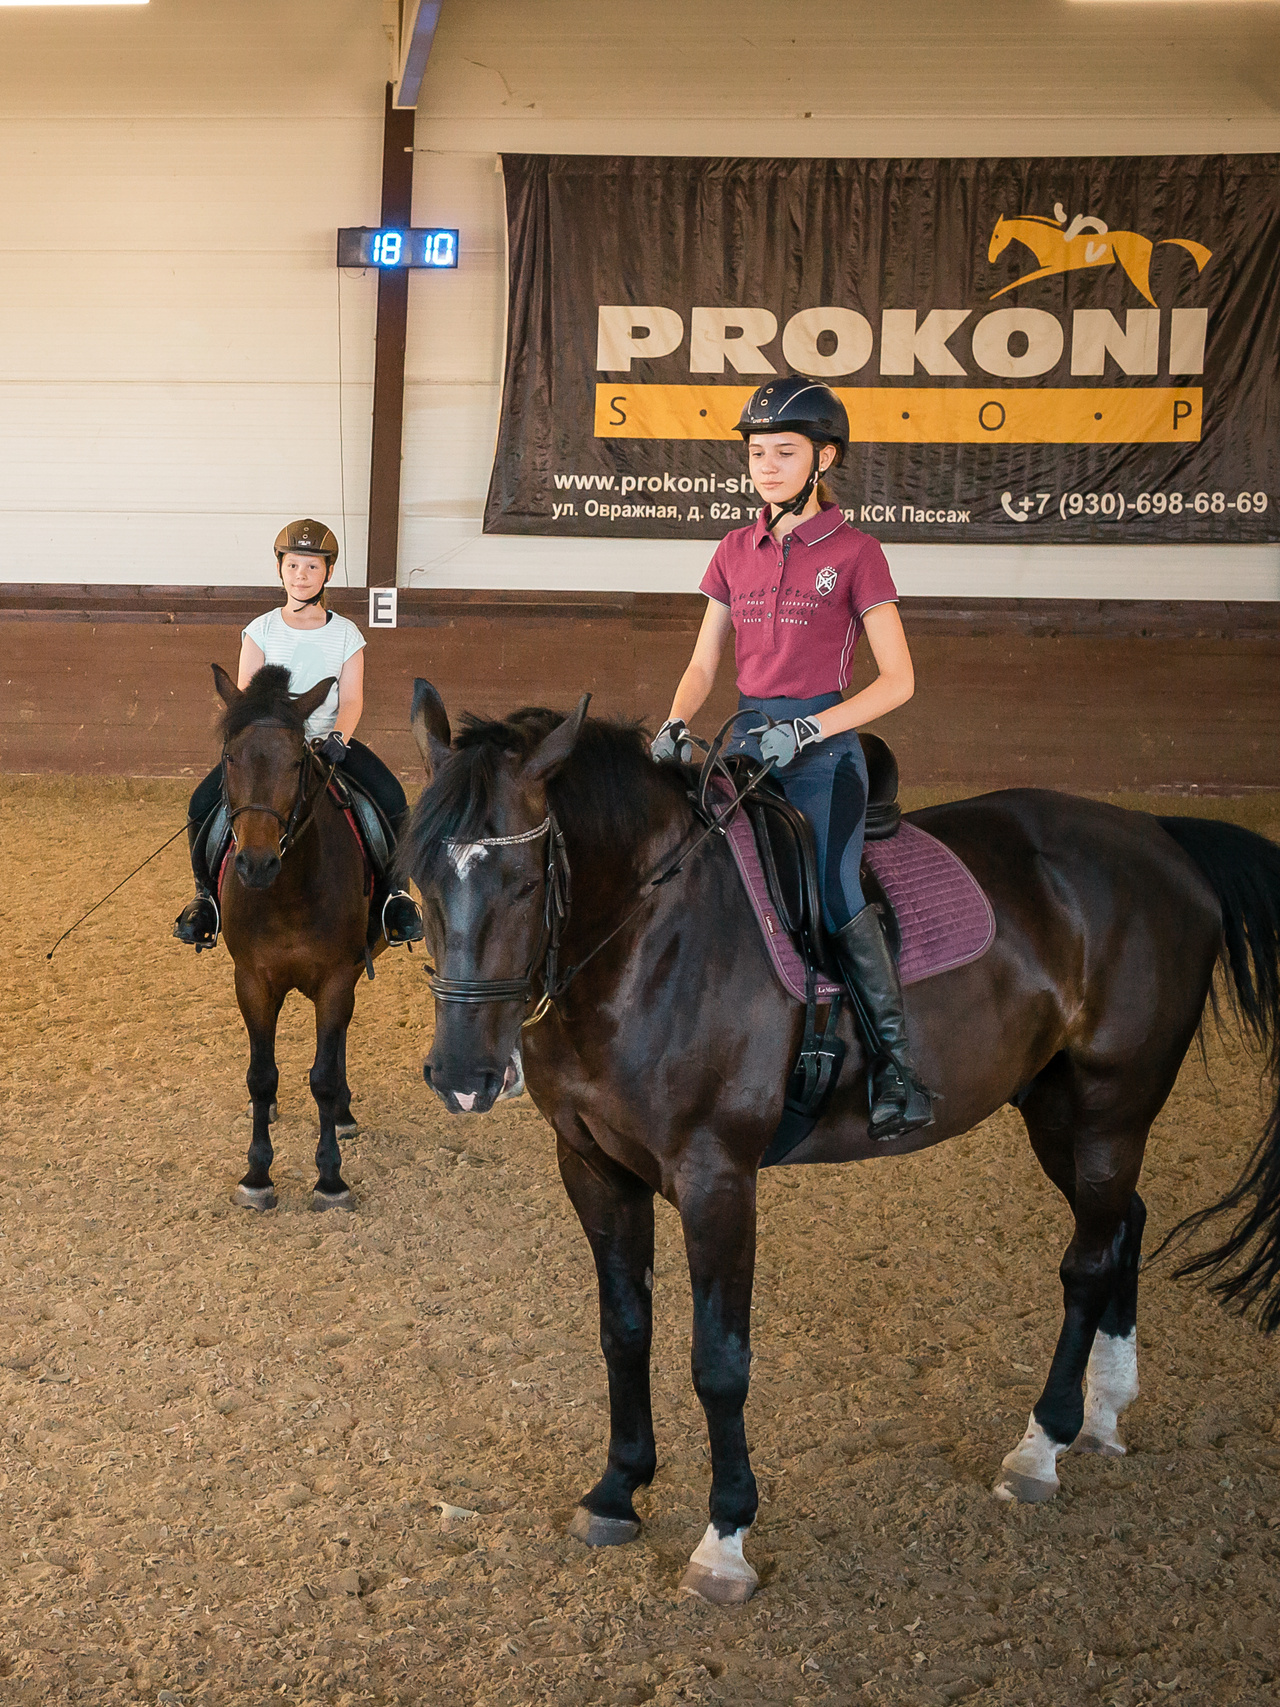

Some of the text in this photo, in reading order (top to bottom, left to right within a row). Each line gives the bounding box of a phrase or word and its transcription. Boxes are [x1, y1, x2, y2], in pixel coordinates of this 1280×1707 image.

[373, 232, 453, 265] 18 10
[596, 305, 1209, 378] PROKONI
[554, 472, 755, 496] www.prokoni-sh
[551, 502, 579, 519] ул.
[584, 499, 682, 522] Овражная,
[686, 505, 705, 522] д.
[710, 502, 741, 520] 62а
[860, 505, 897, 523] КСК
[901, 505, 971, 523] Пассаж
[1018, 491, 1269, 520] +7 (930)-698-68-69
[373, 593, 393, 623] E
